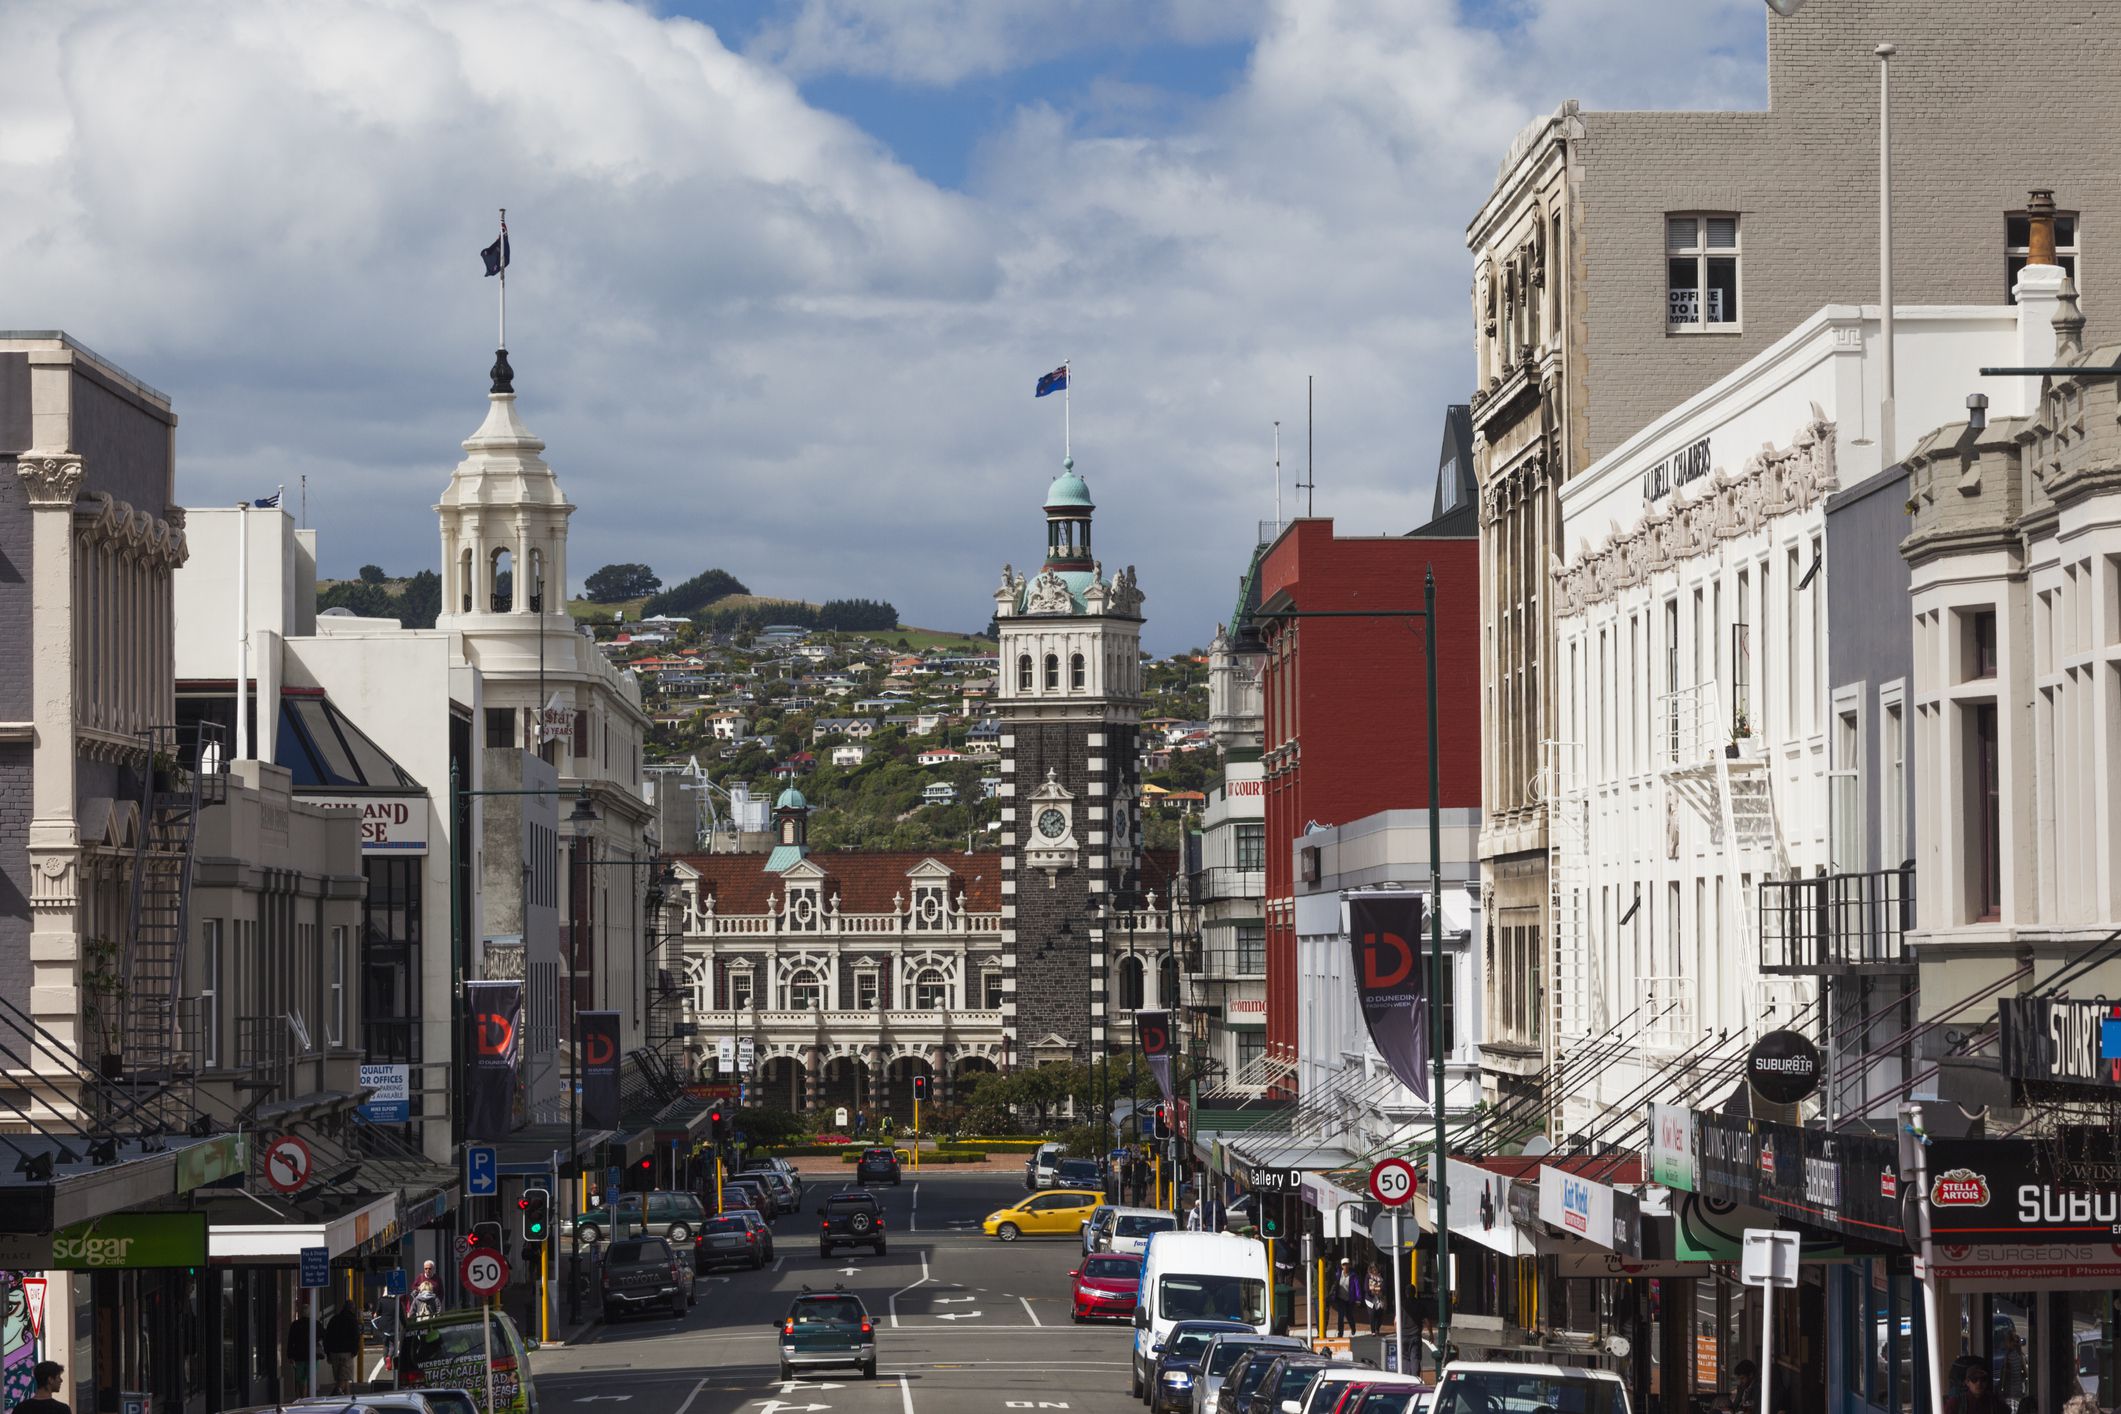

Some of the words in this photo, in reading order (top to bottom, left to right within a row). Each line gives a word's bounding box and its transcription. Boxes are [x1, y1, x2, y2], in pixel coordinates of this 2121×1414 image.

[1670, 291, 1718, 302] OFFIE
[1670, 304, 1689, 314] TO
[1693, 304, 1719, 314] LT
[1673, 436, 1711, 488] CHAMBERS
[550, 727, 573, 736] YEARS
[1375, 993, 1415, 1002] DUNEDIN
[361, 1066, 394, 1075] QUALITY
[1755, 1058, 1813, 1072] SUBURBIA
[373, 1075, 403, 1084] OFFICES
[1731, 1130, 1752, 1166] LIGHT
[474, 1153, 489, 1170] P
[1250, 1169, 1284, 1188] Gallery
[1381, 1173, 1408, 1192] 50
[1942, 1183, 1979, 1192] STELLA
[1942, 1191, 1980, 1200] ARTOIS
[52, 1235, 134, 1266] sugar
[1976, 1248, 2094, 1262] SURGEONS
[105, 1257, 126, 1265] cafe
[472, 1263, 499, 1283] 50
[619, 1273, 661, 1286] TOYOTA
[1959, 1268, 2010, 1279] Leading
[2011, 1267, 2065, 1279] Repairer
[424, 1367, 454, 1382] THEY
[455, 1363, 479, 1378] CALL
[481, 1383, 518, 1399] DSEASE
